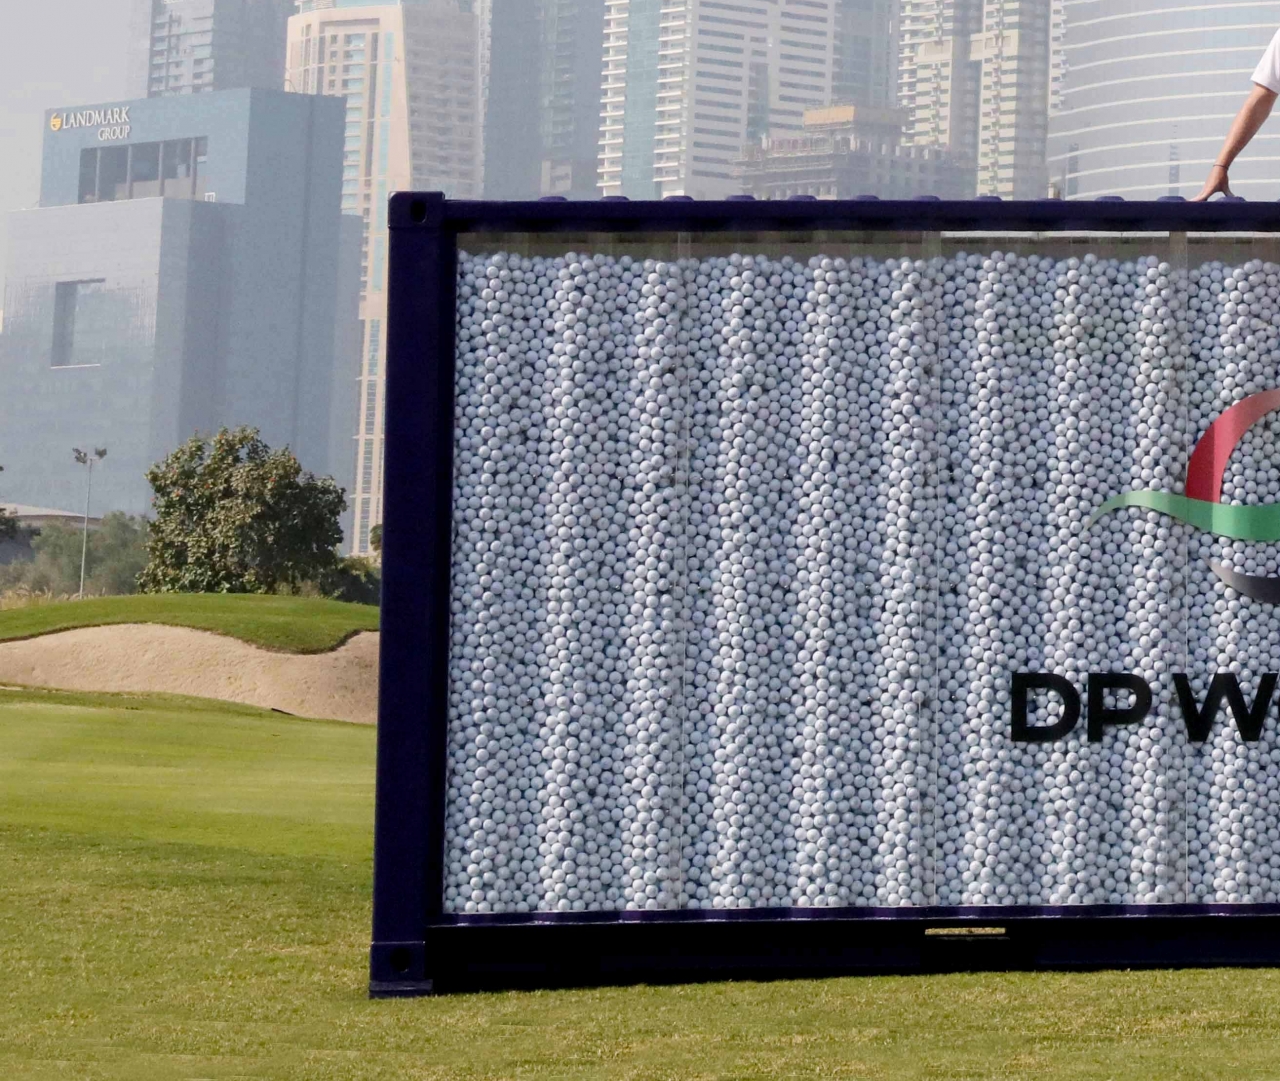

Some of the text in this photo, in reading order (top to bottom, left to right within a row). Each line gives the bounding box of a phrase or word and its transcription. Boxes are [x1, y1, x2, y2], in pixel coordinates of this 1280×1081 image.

[62, 106, 130, 129] LANDMARK
[97, 125, 131, 141] GROUP
[1010, 671, 1153, 743] DP
